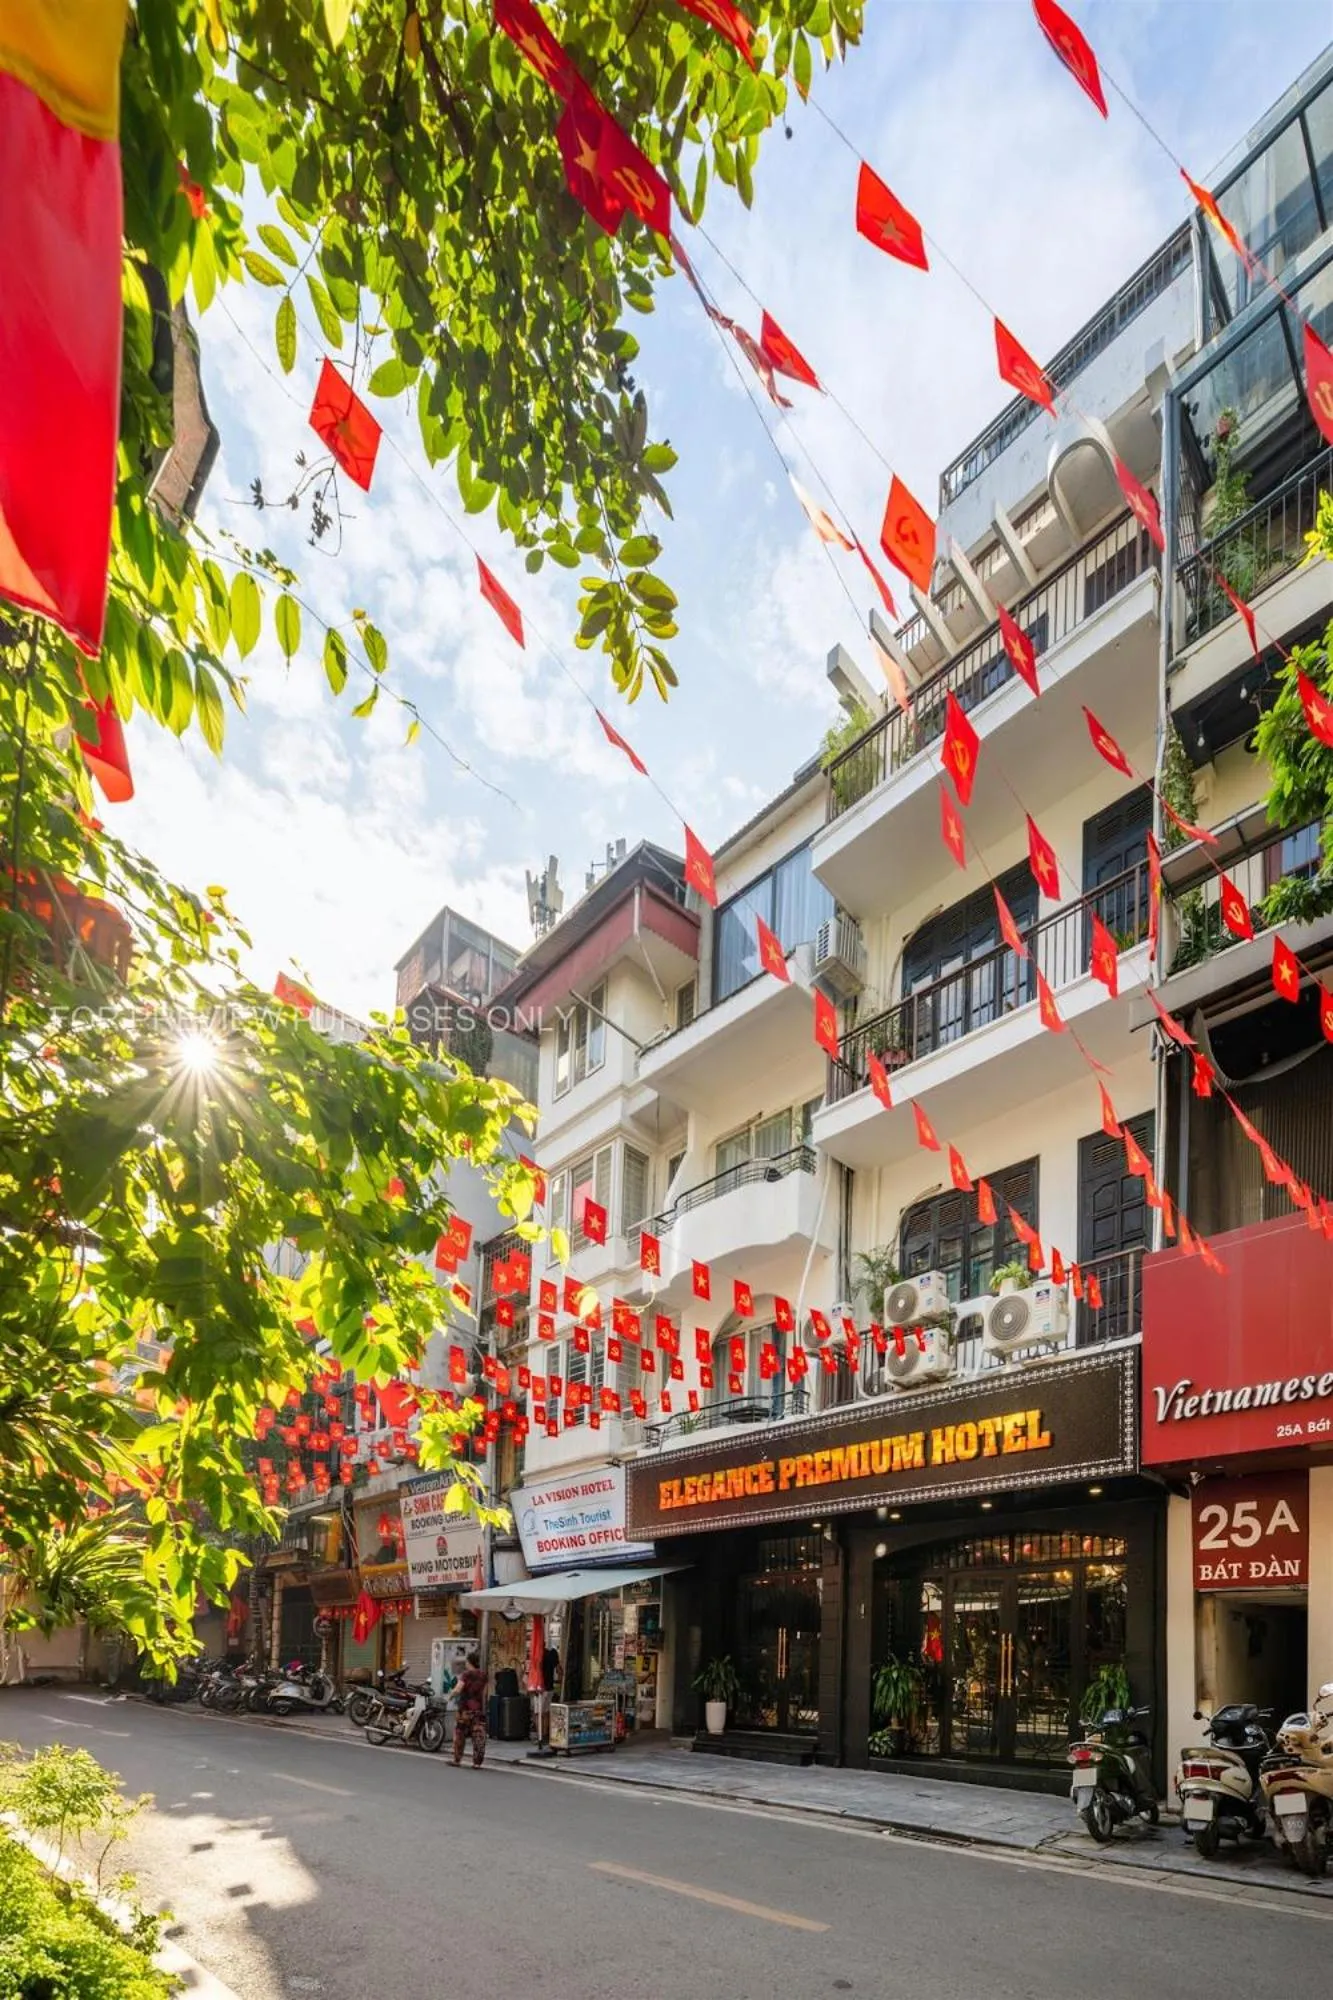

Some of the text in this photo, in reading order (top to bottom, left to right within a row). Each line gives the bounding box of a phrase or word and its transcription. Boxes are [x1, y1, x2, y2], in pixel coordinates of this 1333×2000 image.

[1153, 1371, 1333, 1422] Vietnamese
[1276, 1418, 1332, 1438] 25A Bát
[659, 1408, 1051, 1510] ELEGANCE PREMIUM HOTEL
[531, 1479, 616, 1506] LA VISION HOTEL
[579, 1509, 612, 1524] Tourist
[1198, 1500, 1300, 1550] 25A
[537, 1534, 586, 1553] BOOKING
[588, 1528, 626, 1545] OFFIC
[1198, 1554, 1301, 1581] BÁT ĐÀN
